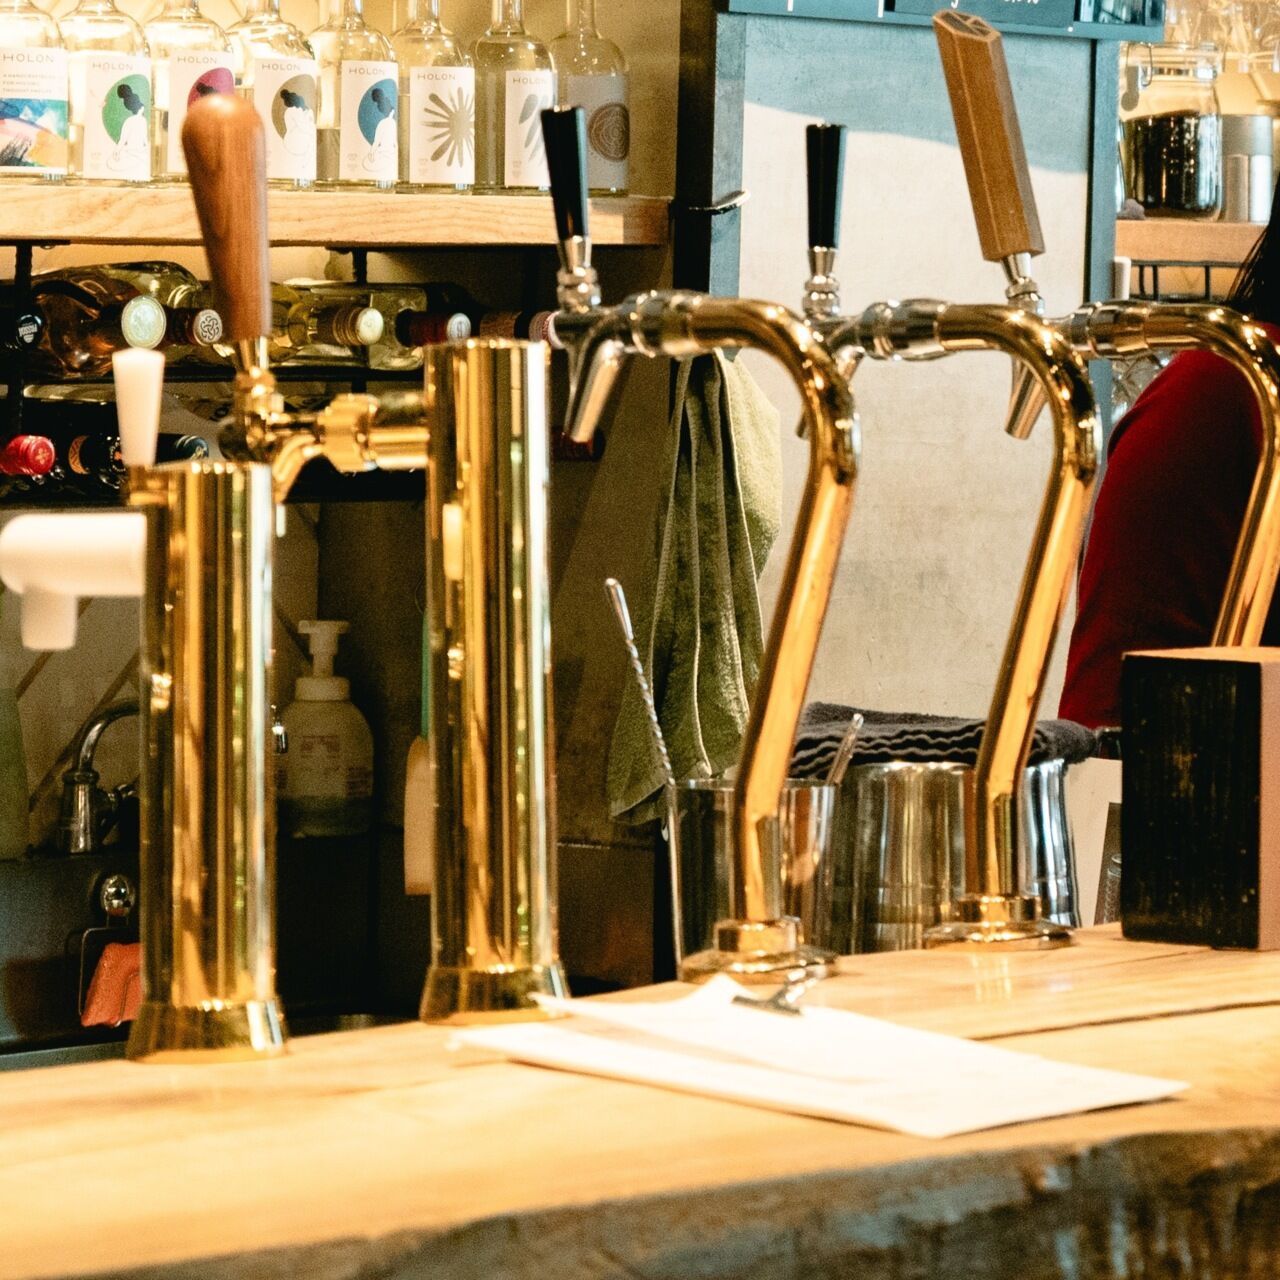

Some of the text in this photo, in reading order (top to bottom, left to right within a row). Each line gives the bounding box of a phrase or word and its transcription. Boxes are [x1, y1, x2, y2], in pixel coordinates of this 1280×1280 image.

[3, 53, 54, 63] HOLON
[177, 56, 217, 64] HOLON
[92, 62, 134, 71] HOLON
[261, 63, 301, 71] HOLON
[348, 67, 386, 75] HOLON
[417, 73, 456, 81] HOLON
